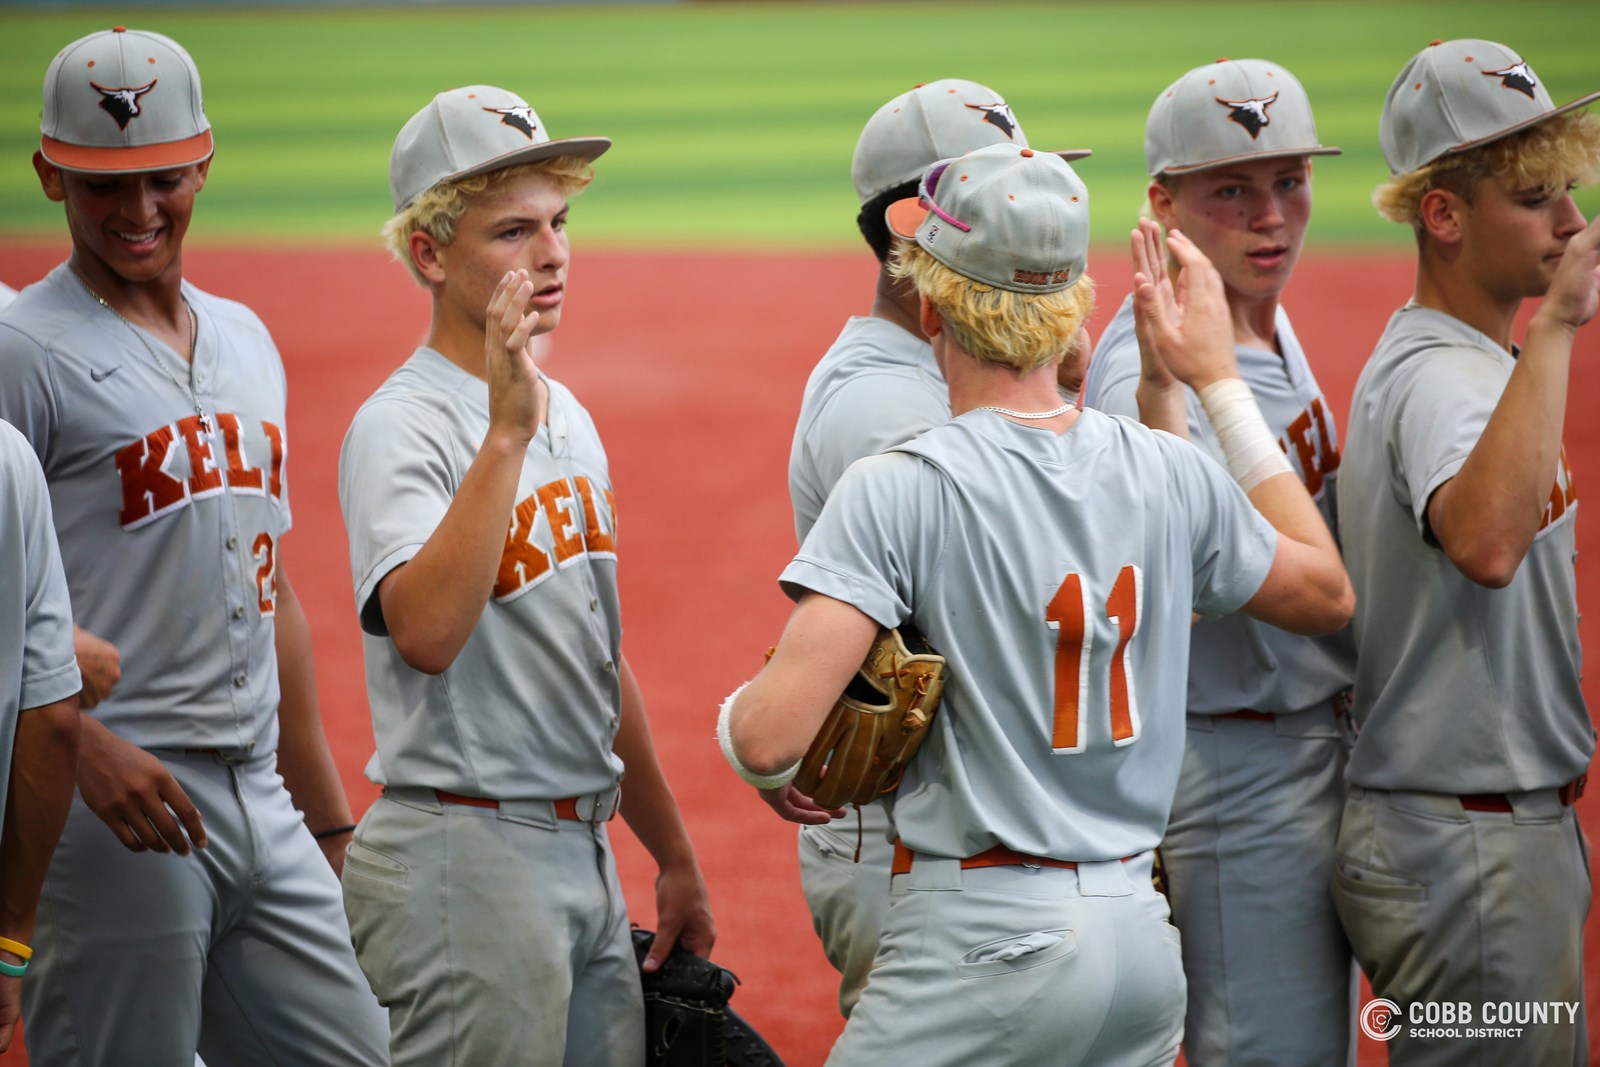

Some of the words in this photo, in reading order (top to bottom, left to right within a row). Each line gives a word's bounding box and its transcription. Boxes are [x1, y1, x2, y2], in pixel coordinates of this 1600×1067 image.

[1278, 397, 1341, 501] EL
[494, 475, 617, 605] KEL
[1045, 564, 1143, 755] 11
